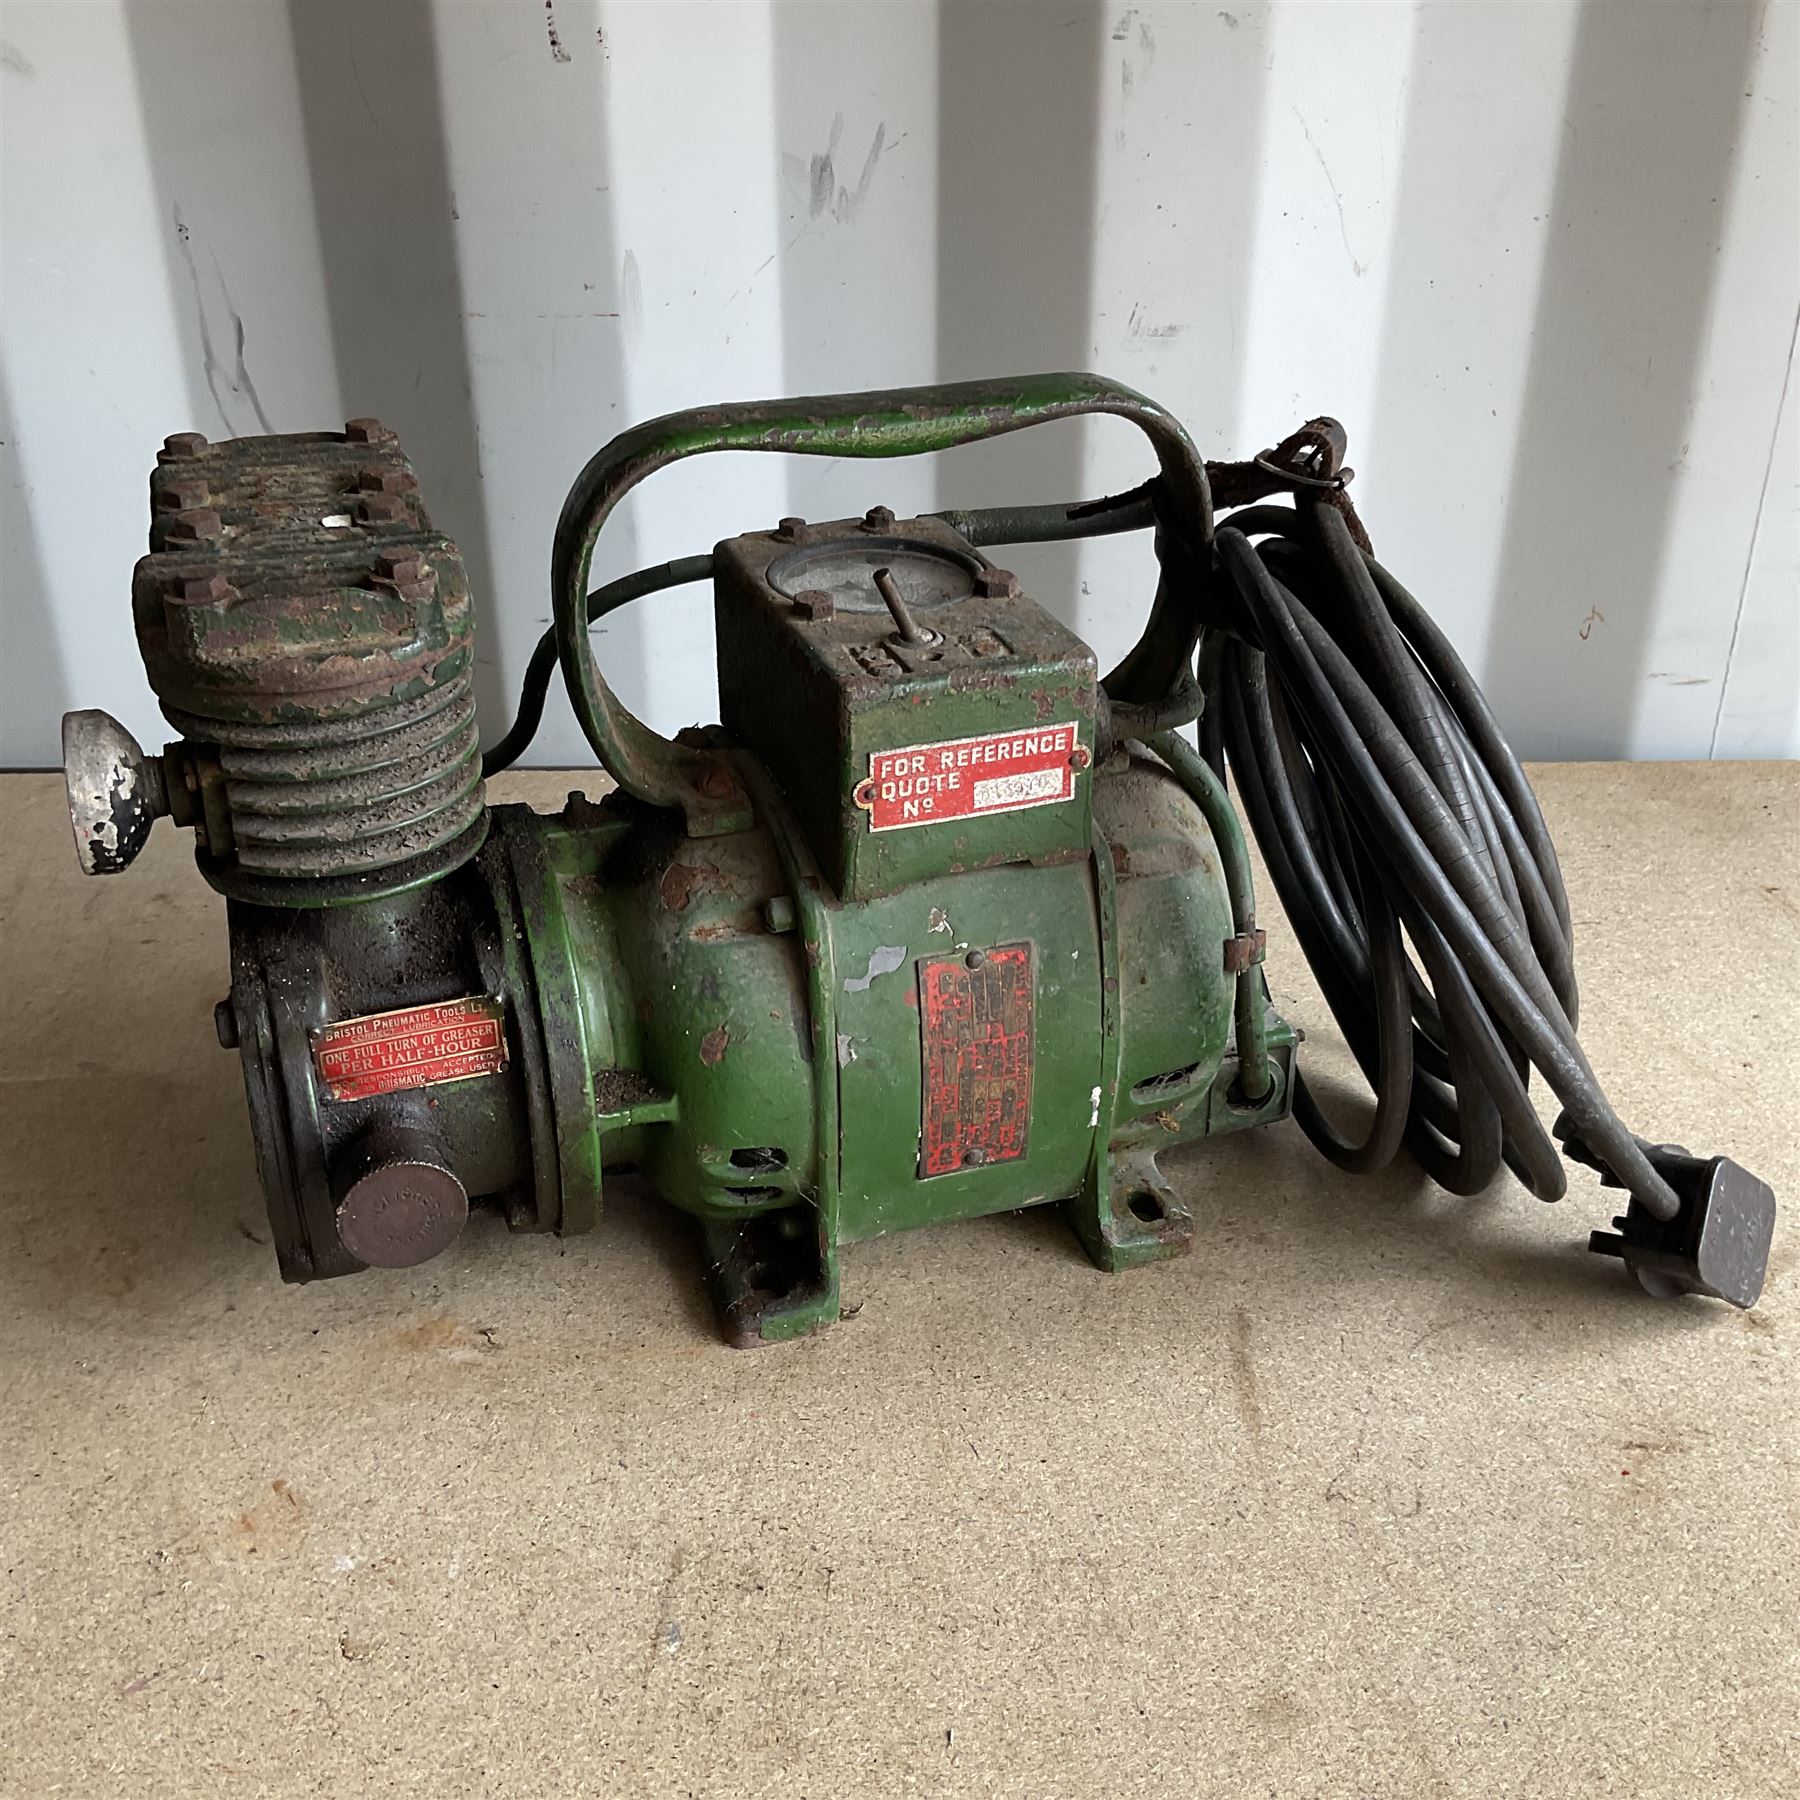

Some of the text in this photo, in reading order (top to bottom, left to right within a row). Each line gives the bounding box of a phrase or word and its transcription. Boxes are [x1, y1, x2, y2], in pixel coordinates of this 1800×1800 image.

[881, 733, 1068, 779] FOR REFERENCE
[881, 771, 961, 803] QUOTE
[325, 1025, 369, 1042] BRISTOL
[373, 1012, 430, 1033] PNEUMATIC
[434, 1006, 466, 1019] TOOLS
[351, 1015, 465, 1043] CORRECT LUBRICATION
[325, 1024, 493, 1065] ONE FULL TURN OF GREASER
[341, 1038, 482, 1074] PER HALF-HOUR
[429, 1066, 464, 1080] GREASE
[469, 1060, 495, 1072] USED
